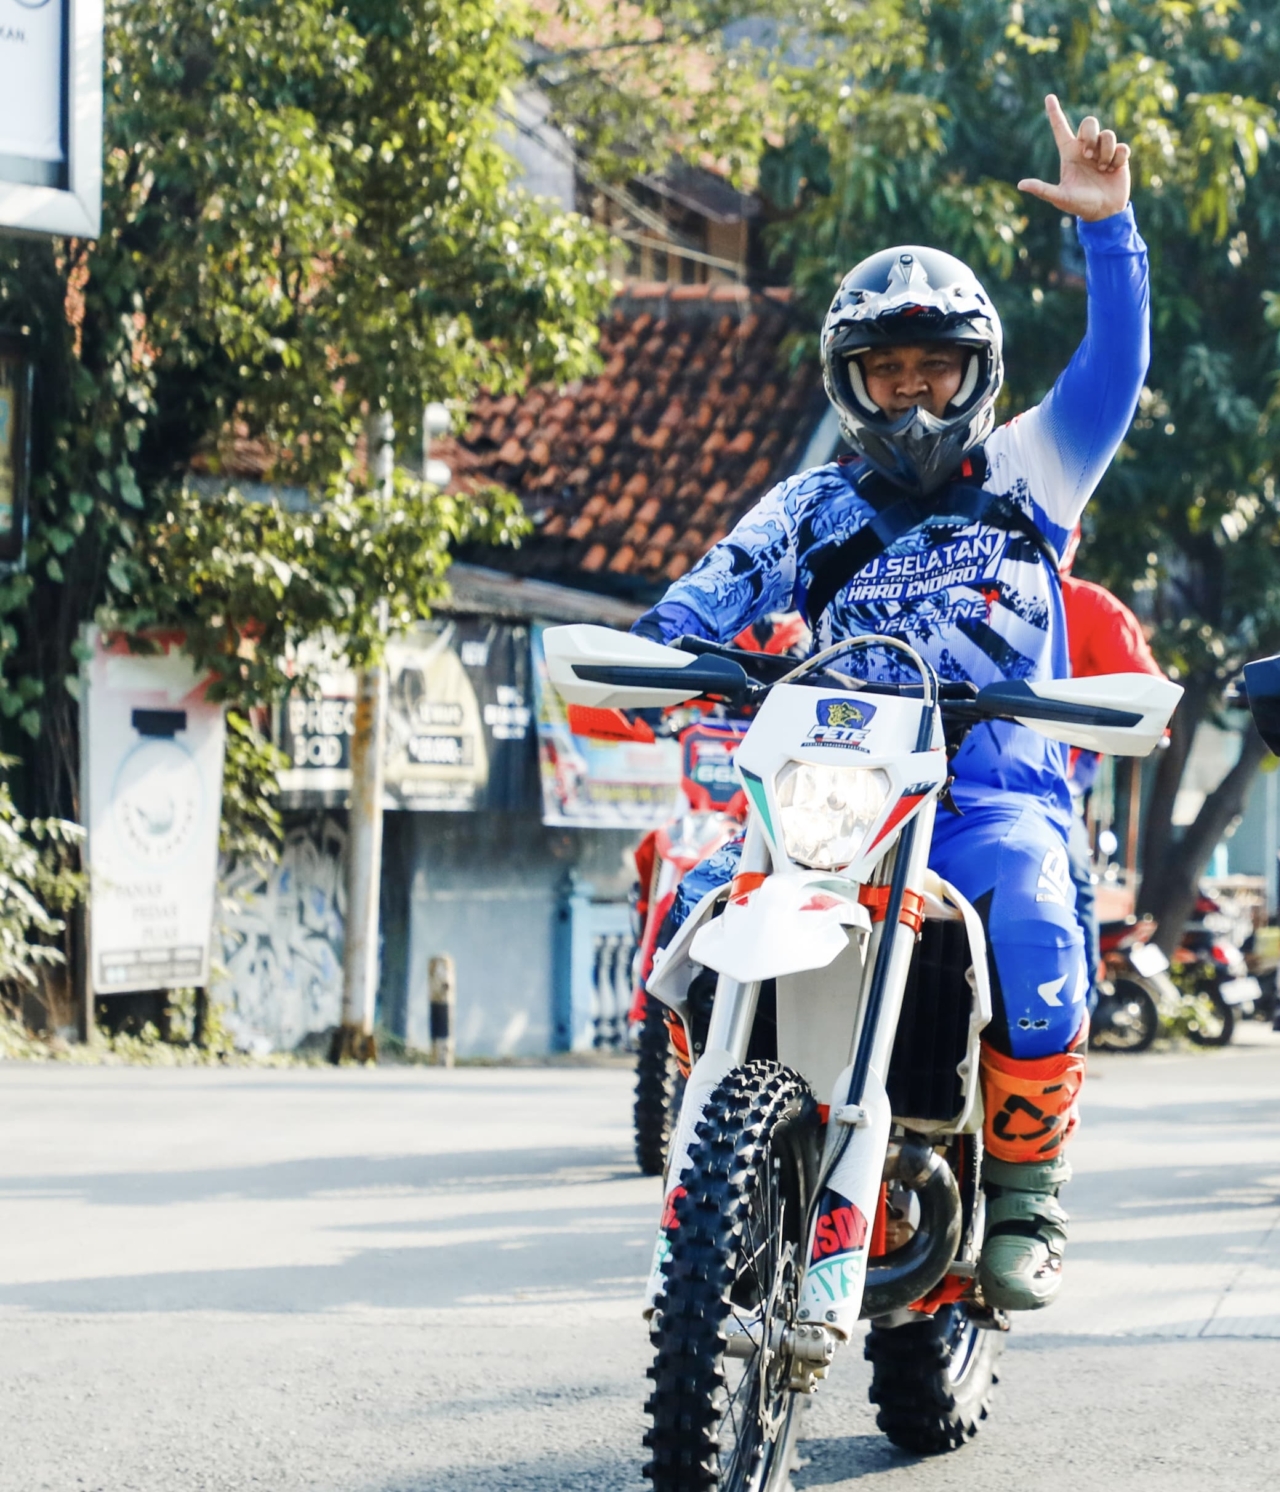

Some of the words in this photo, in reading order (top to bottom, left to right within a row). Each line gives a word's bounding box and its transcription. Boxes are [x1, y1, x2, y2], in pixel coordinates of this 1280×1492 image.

[885, 536, 992, 577] SELATAN
[847, 583, 903, 602] HARD
[808, 725, 870, 742] PETE
